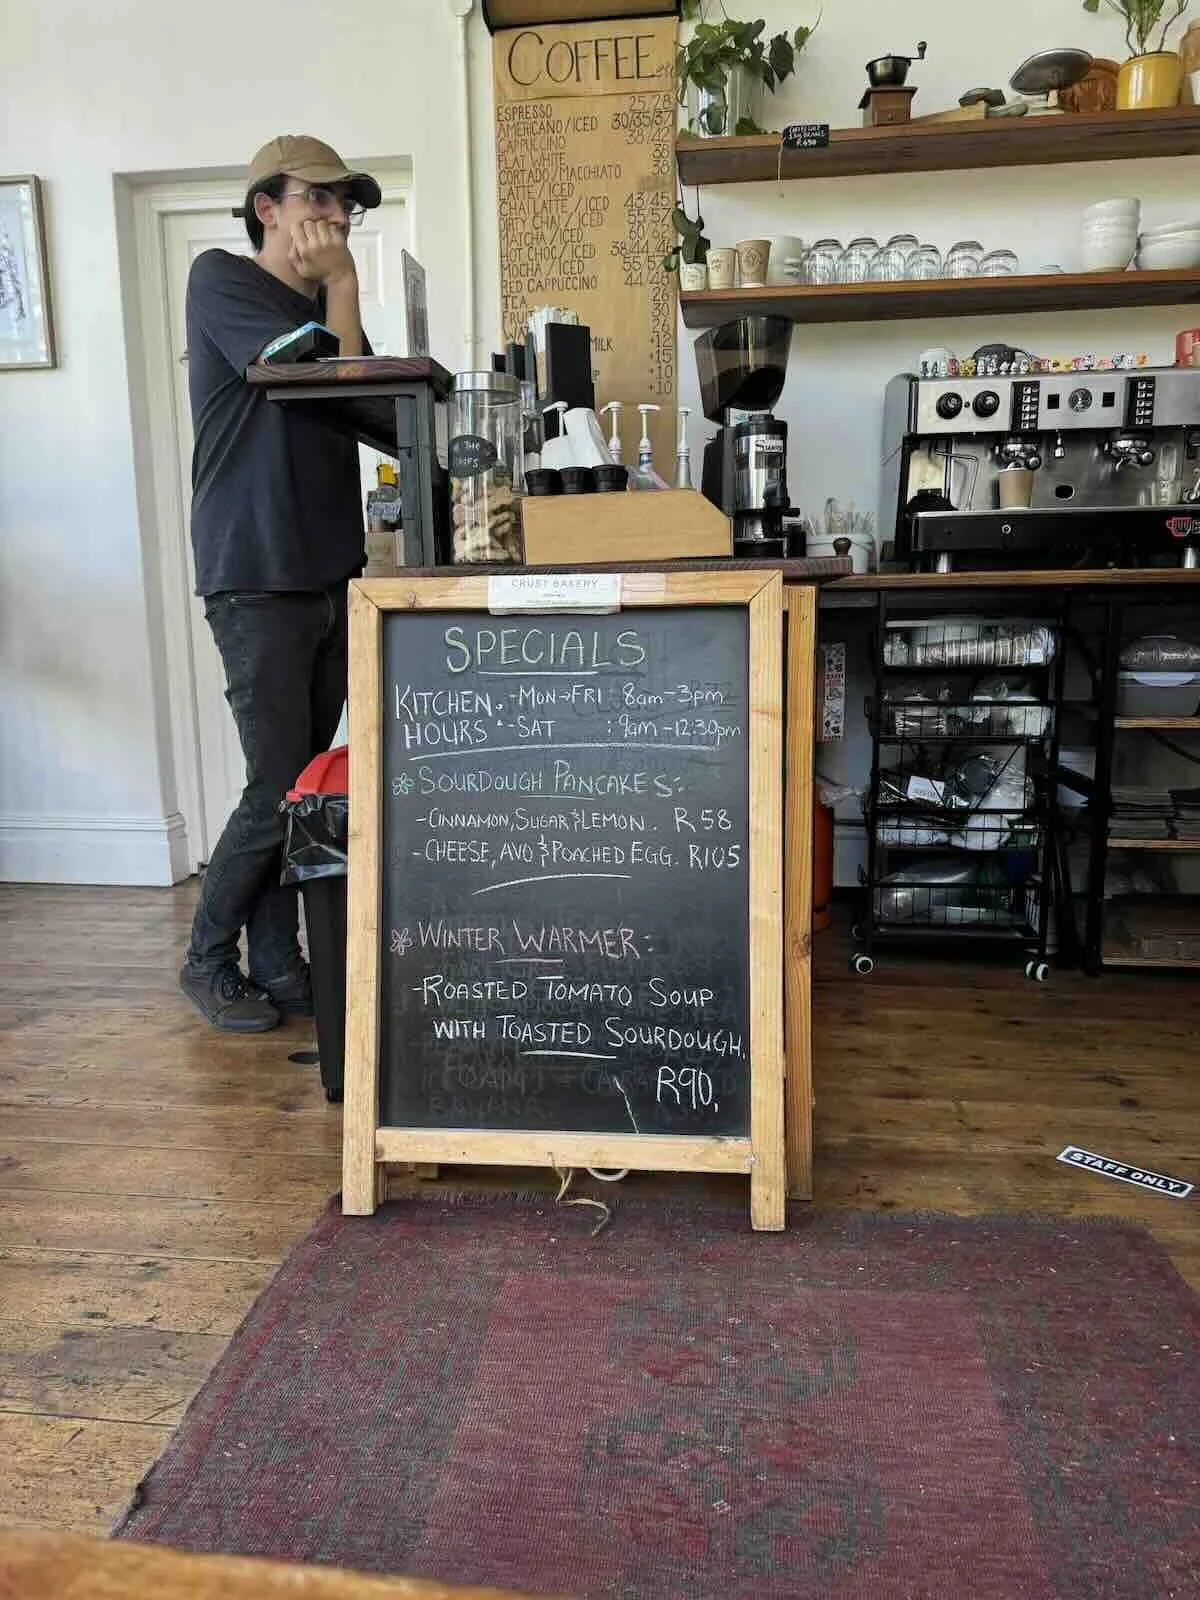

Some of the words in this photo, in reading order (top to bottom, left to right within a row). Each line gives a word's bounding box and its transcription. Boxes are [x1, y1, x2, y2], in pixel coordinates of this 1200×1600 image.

[508, 31, 655, 86] COFFEE
[497, 104, 553, 121] ESPRESSO
[498, 152, 526, 170] FLAT
[530, 151, 566, 168] WHITE
[527, 275, 599, 293] CAPPUCCINO
[503, 295, 527, 309] TEA
[444, 626, 646, 673] SPECIALS
[418, 765, 542, 795] SOURDOUGH
[500, 840, 534, 863] AVO
[552, 841, 625, 864] POACHED
[418, 920, 505, 955] WINTER
[536, 976, 633, 1007] TOMATO
[649, 977, 714, 1007] SOUP
[432, 1018, 486, 1039] WITH
[496, 1014, 592, 1044] TOASTED
[1070, 1152, 1128, 1174] STAFF
[1130, 1171, 1181, 1190] ONLY
